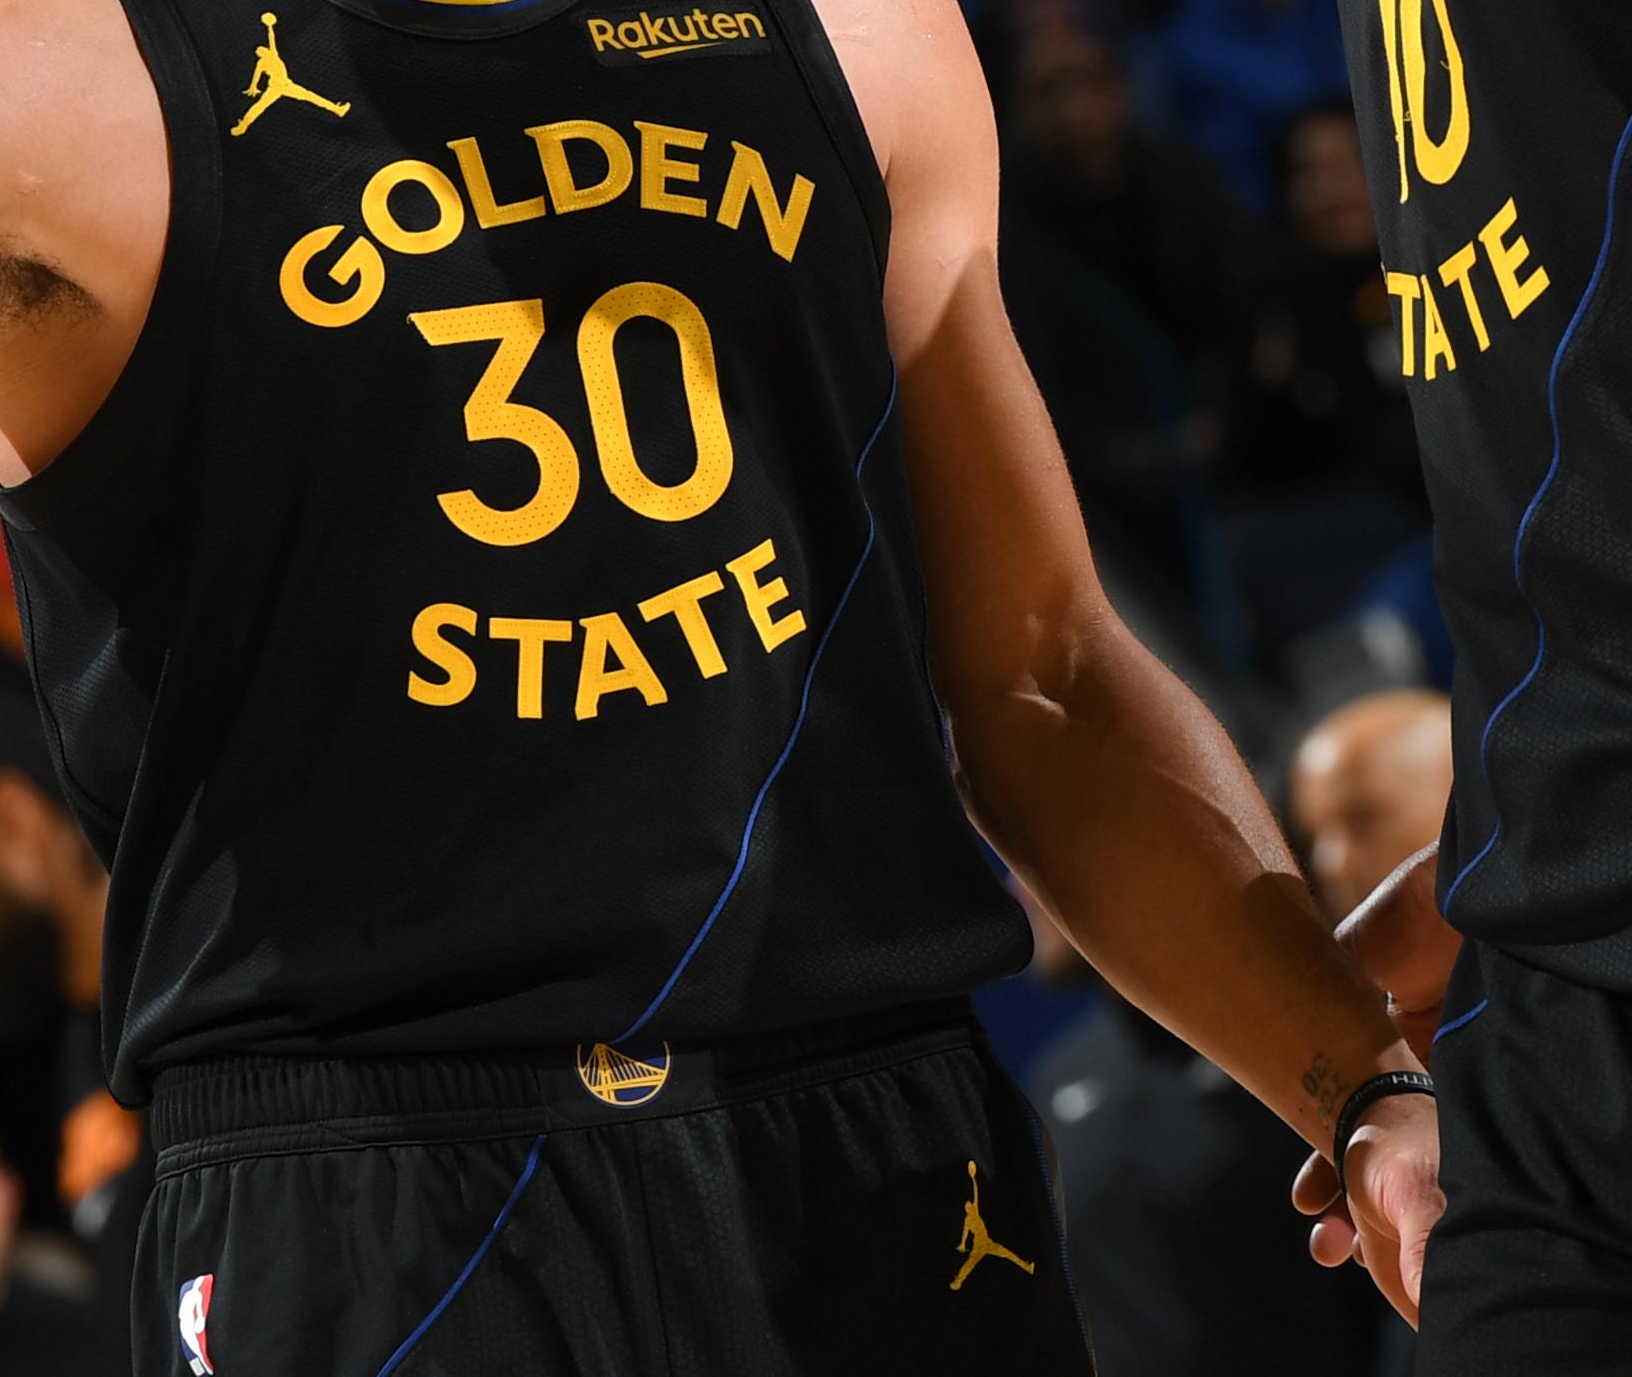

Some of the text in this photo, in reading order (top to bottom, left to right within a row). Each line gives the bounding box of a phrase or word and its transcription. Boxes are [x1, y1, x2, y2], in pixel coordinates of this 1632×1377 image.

[586, 7, 767, 53] Rakuten
[278, 119, 816, 328] GOLDEN
[1380, 198, 1551, 382] TATE
[407, 281, 734, 547] 30
[407, 538, 807, 721] STATE
